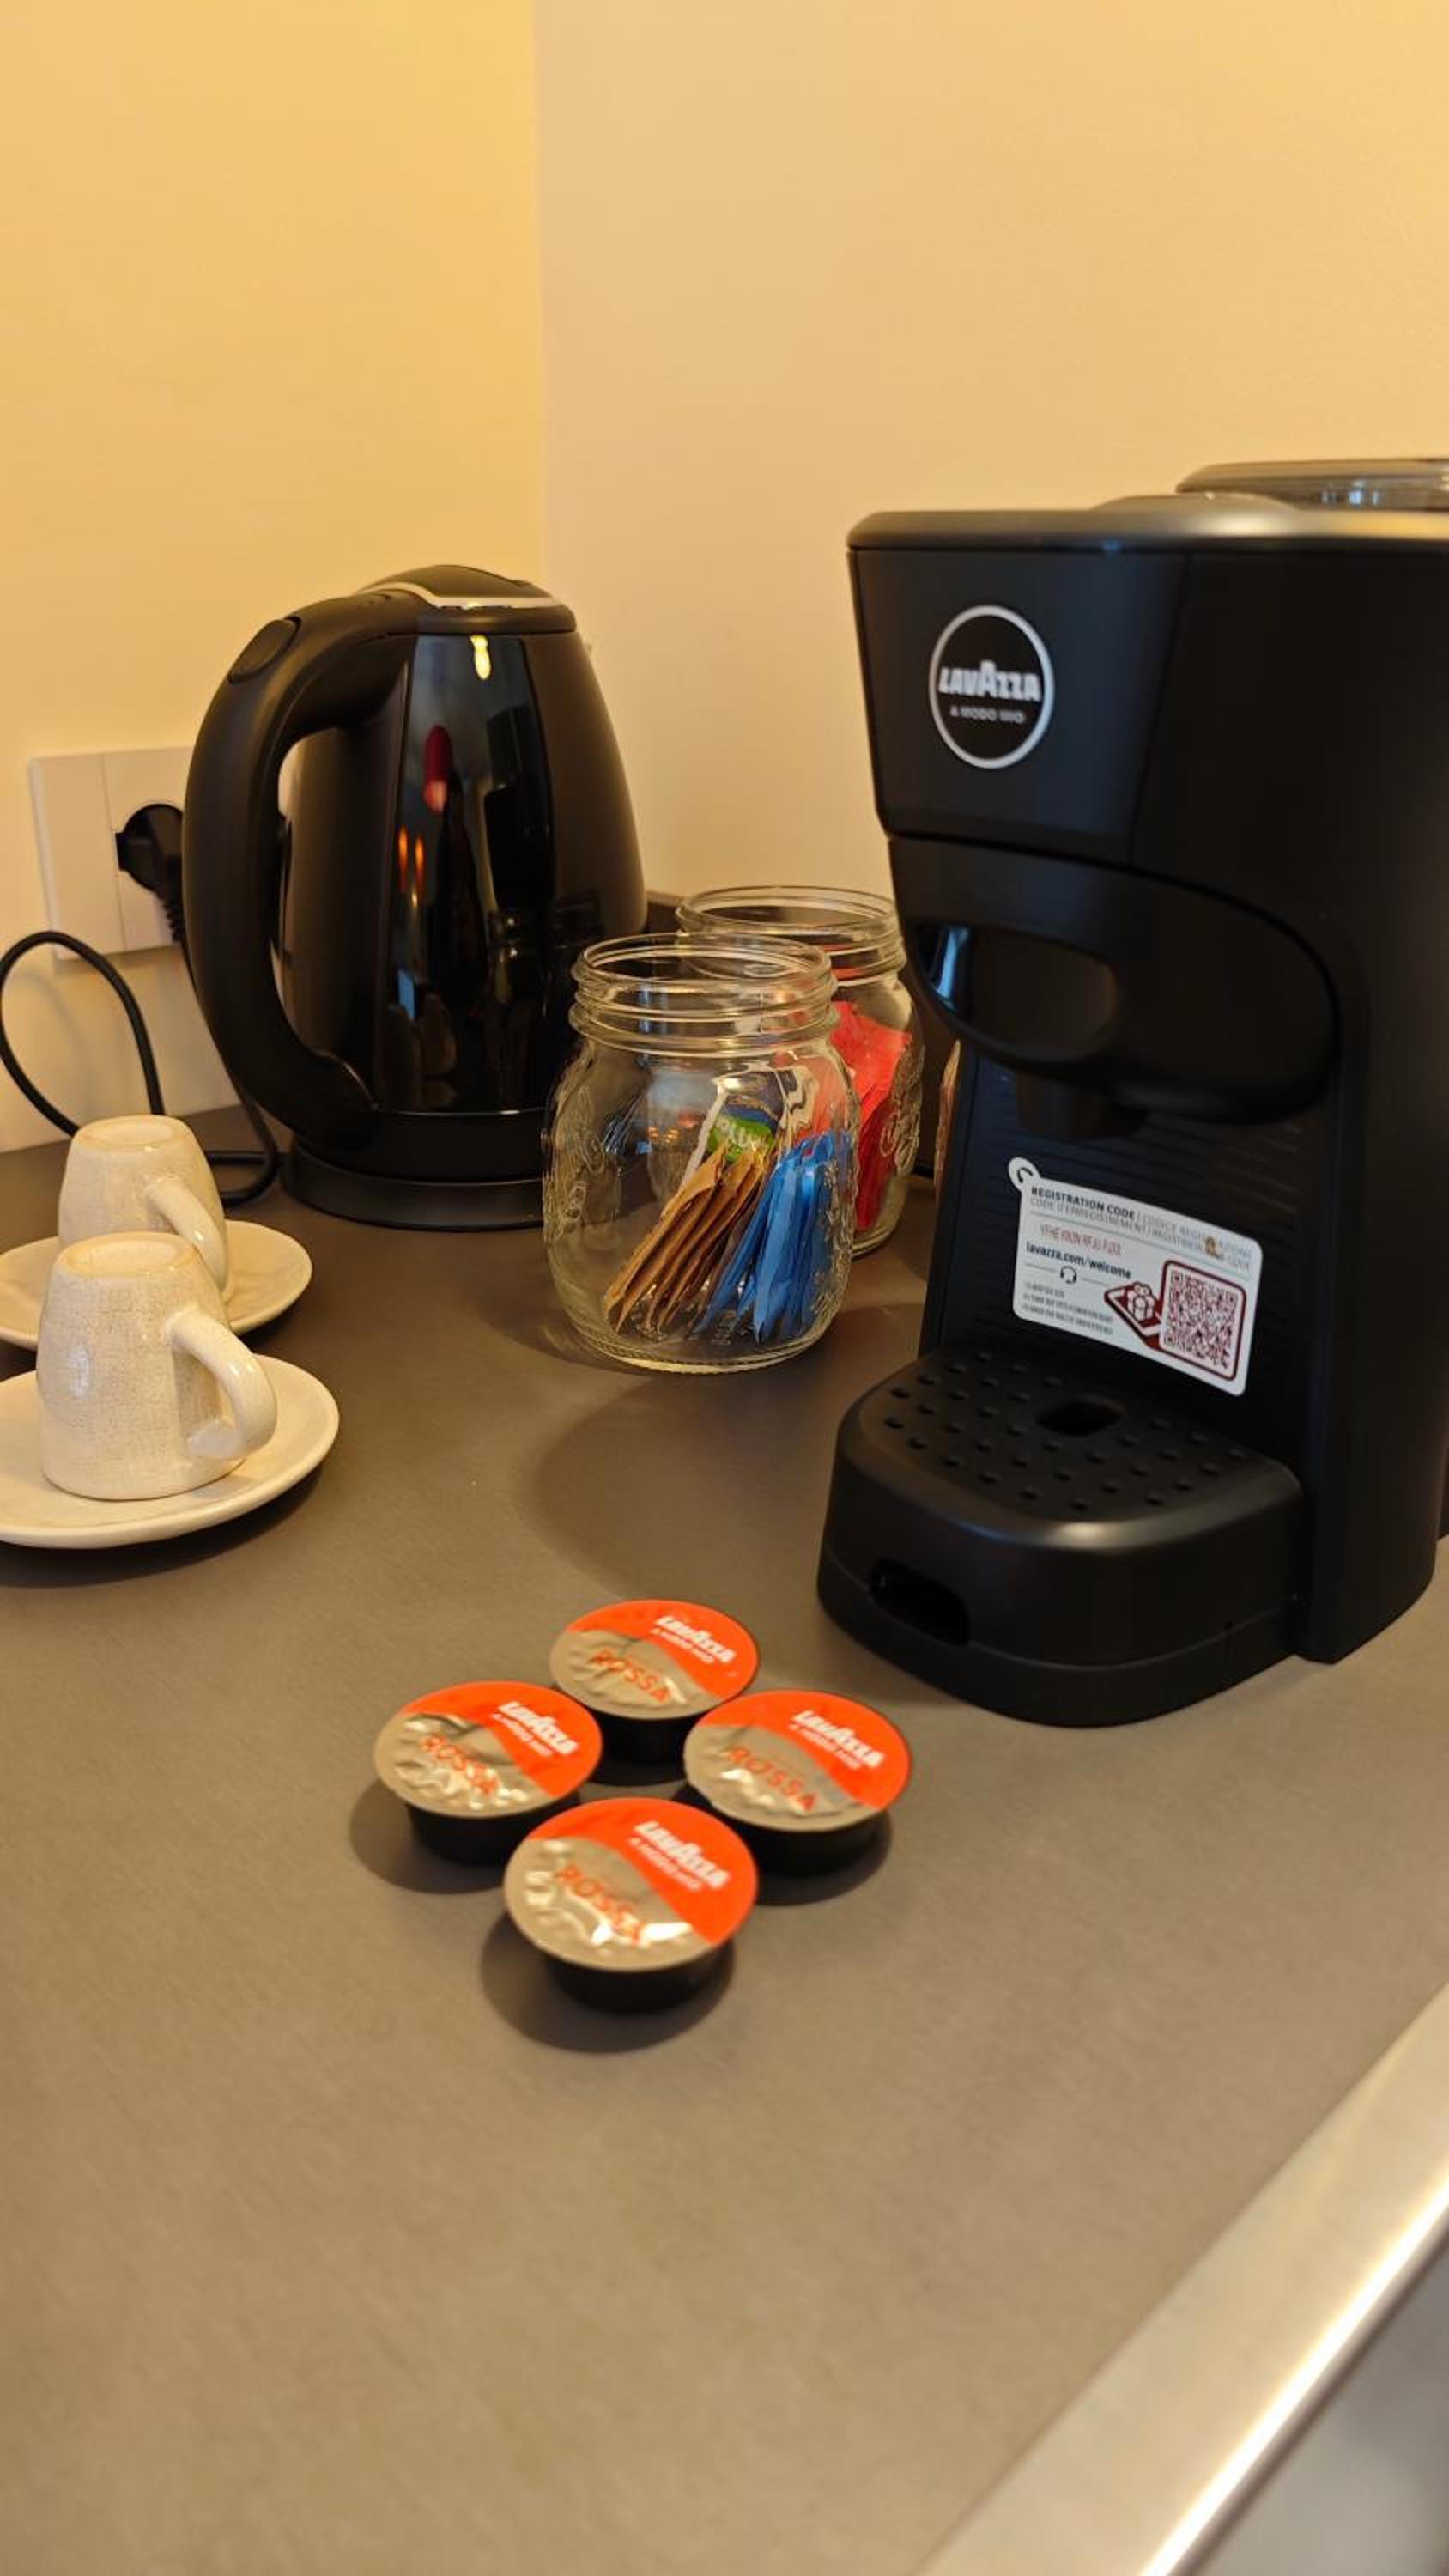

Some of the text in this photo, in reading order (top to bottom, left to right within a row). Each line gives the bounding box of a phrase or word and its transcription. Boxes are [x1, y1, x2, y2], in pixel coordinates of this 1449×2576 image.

[938, 659, 1042, 702] LAVAZZA
[949, 706, 960, 717] A
[1031, 1186, 1105, 1212] REGISTRATION
[1106, 1204, 1135, 1220] CODE
[1026, 1241, 1131, 1279] lavazza.com/welcome
[654, 1616, 737, 1663] LAVAZZA
[497, 1699, 579, 1755] LAVAZZA
[793, 1710, 886, 1769] LAVAZZA
[725, 1746, 818, 1811] ROSSA
[633, 1820, 730, 1889] LAVAZZA
